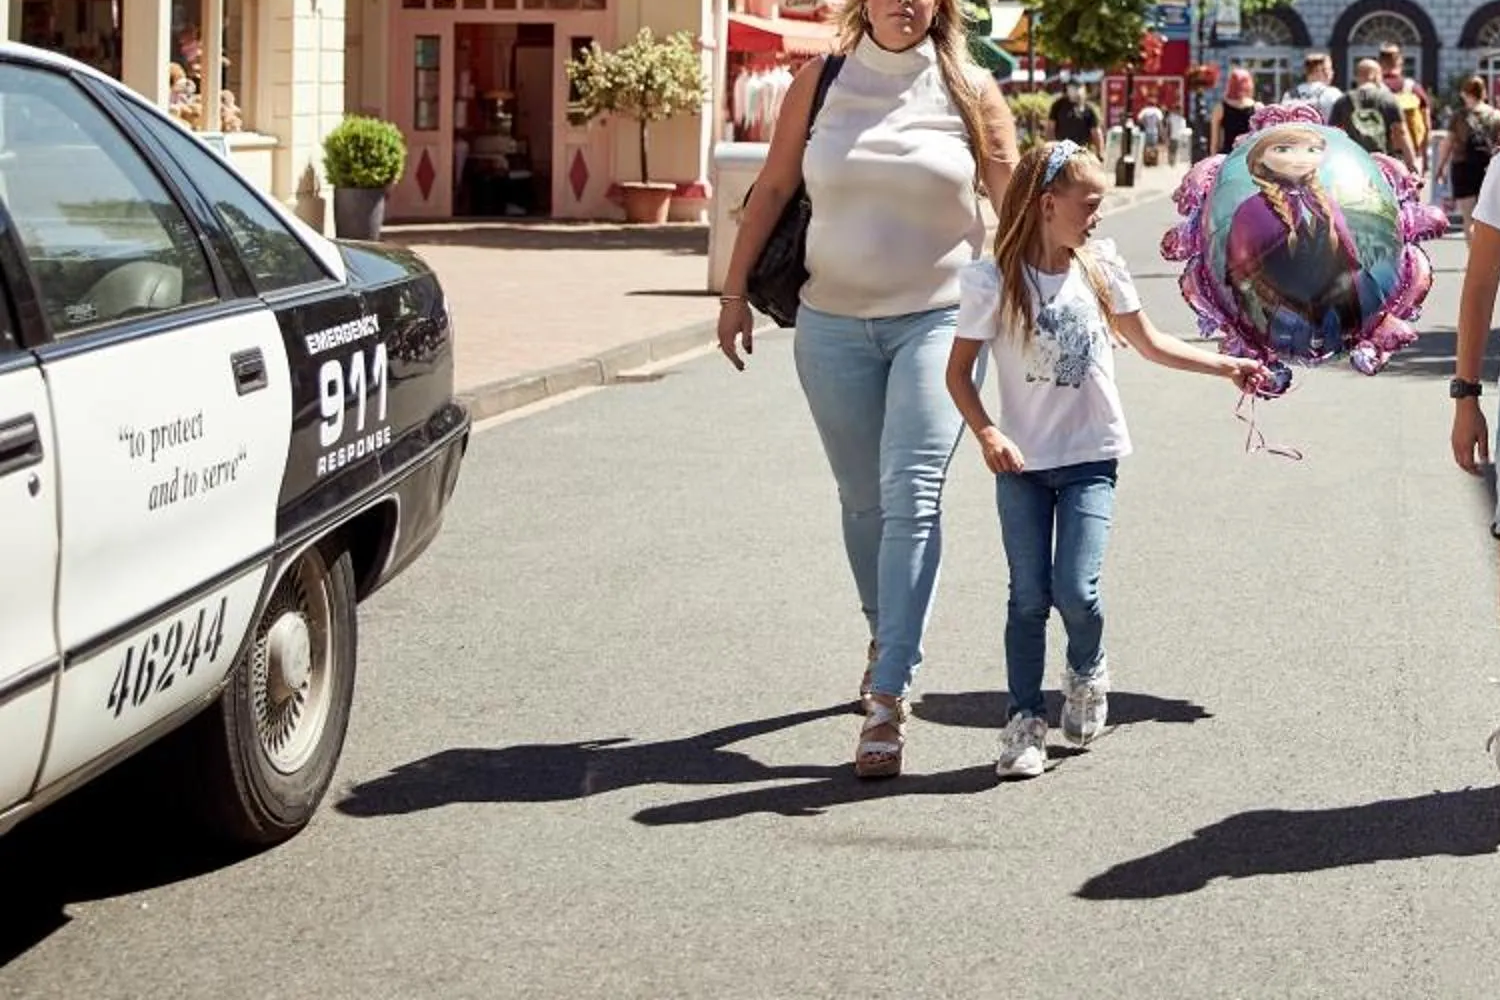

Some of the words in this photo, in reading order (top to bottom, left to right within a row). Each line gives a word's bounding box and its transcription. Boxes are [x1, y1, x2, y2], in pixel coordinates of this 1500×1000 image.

[304, 313, 381, 356] EMERGENCY
[319, 341, 388, 447] 911
[150, 409, 204, 464] protect
[316, 425, 392, 478] RESPONSE
[149, 466, 179, 511] and
[183, 470, 198, 499] to
[107, 596, 228, 719] 46244
